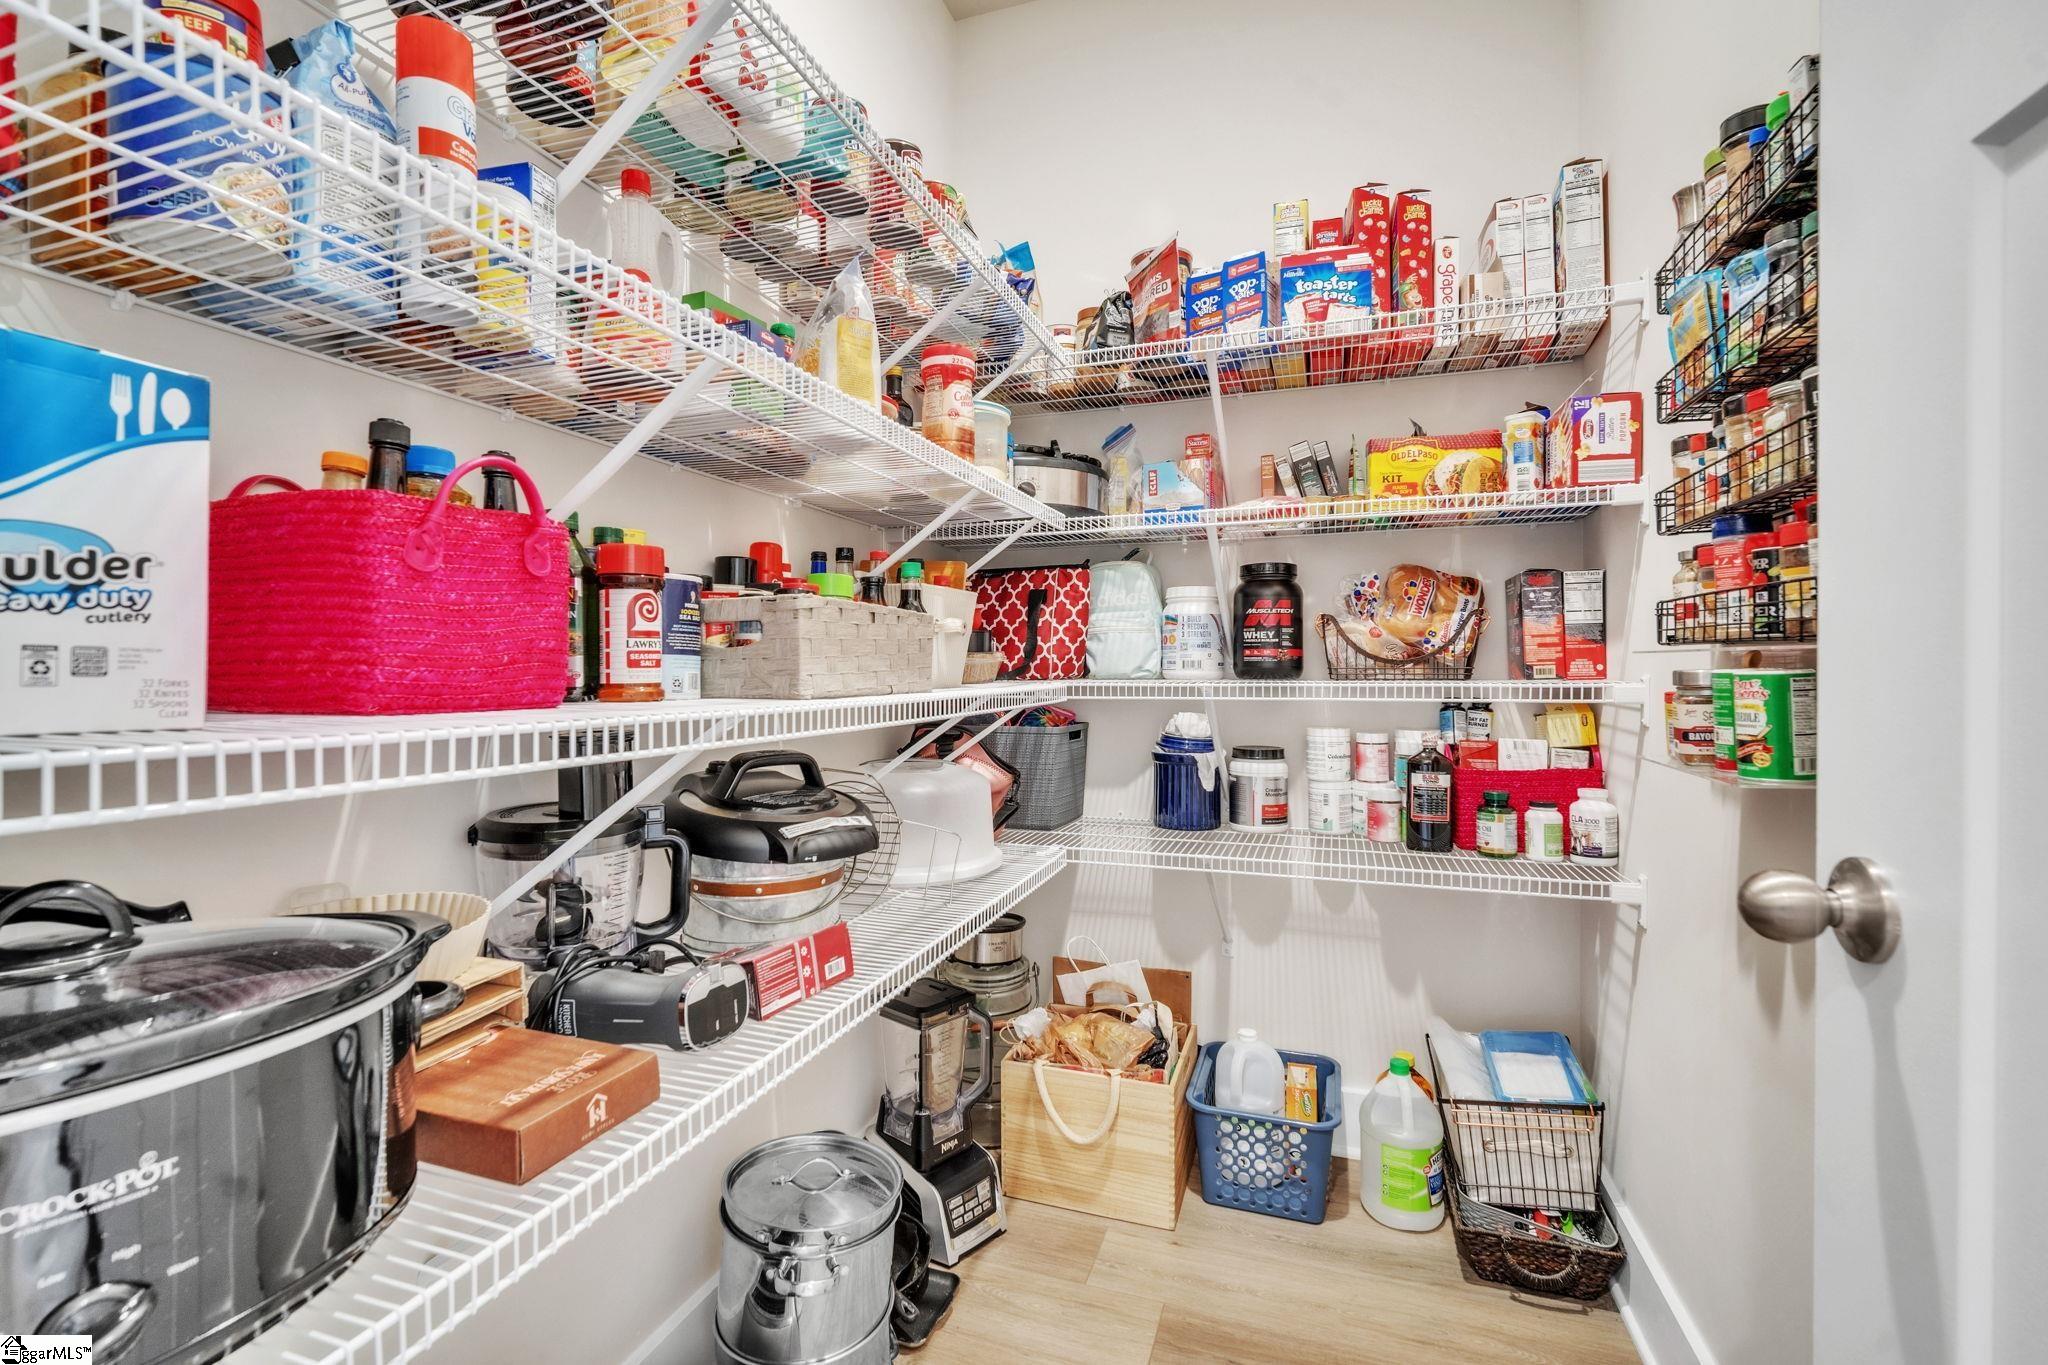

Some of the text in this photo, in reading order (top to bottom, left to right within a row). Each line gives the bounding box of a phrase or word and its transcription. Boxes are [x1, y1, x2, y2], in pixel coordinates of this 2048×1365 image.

[1361, 199, 1383, 208] Lucky
[1406, 204, 1426, 213] Lucky
[1358, 206, 1384, 218] Charms
[1403, 211, 1427, 221] Charms
[1295, 274, 1359, 293] toaster
[1437, 263, 1457, 305] grape
[1322, 290, 1357, 303] tarts
[1573, 400, 1585, 410] 12
[1149, 471, 1157, 489] CLIF
[1382, 475, 1402, 483] KIT
[77, 588, 151, 612] duty
[1412, 577, 1432, 616] WONDER
[86, 612, 151, 624] cutlery
[1243, 631, 1276, 639] WHEY
